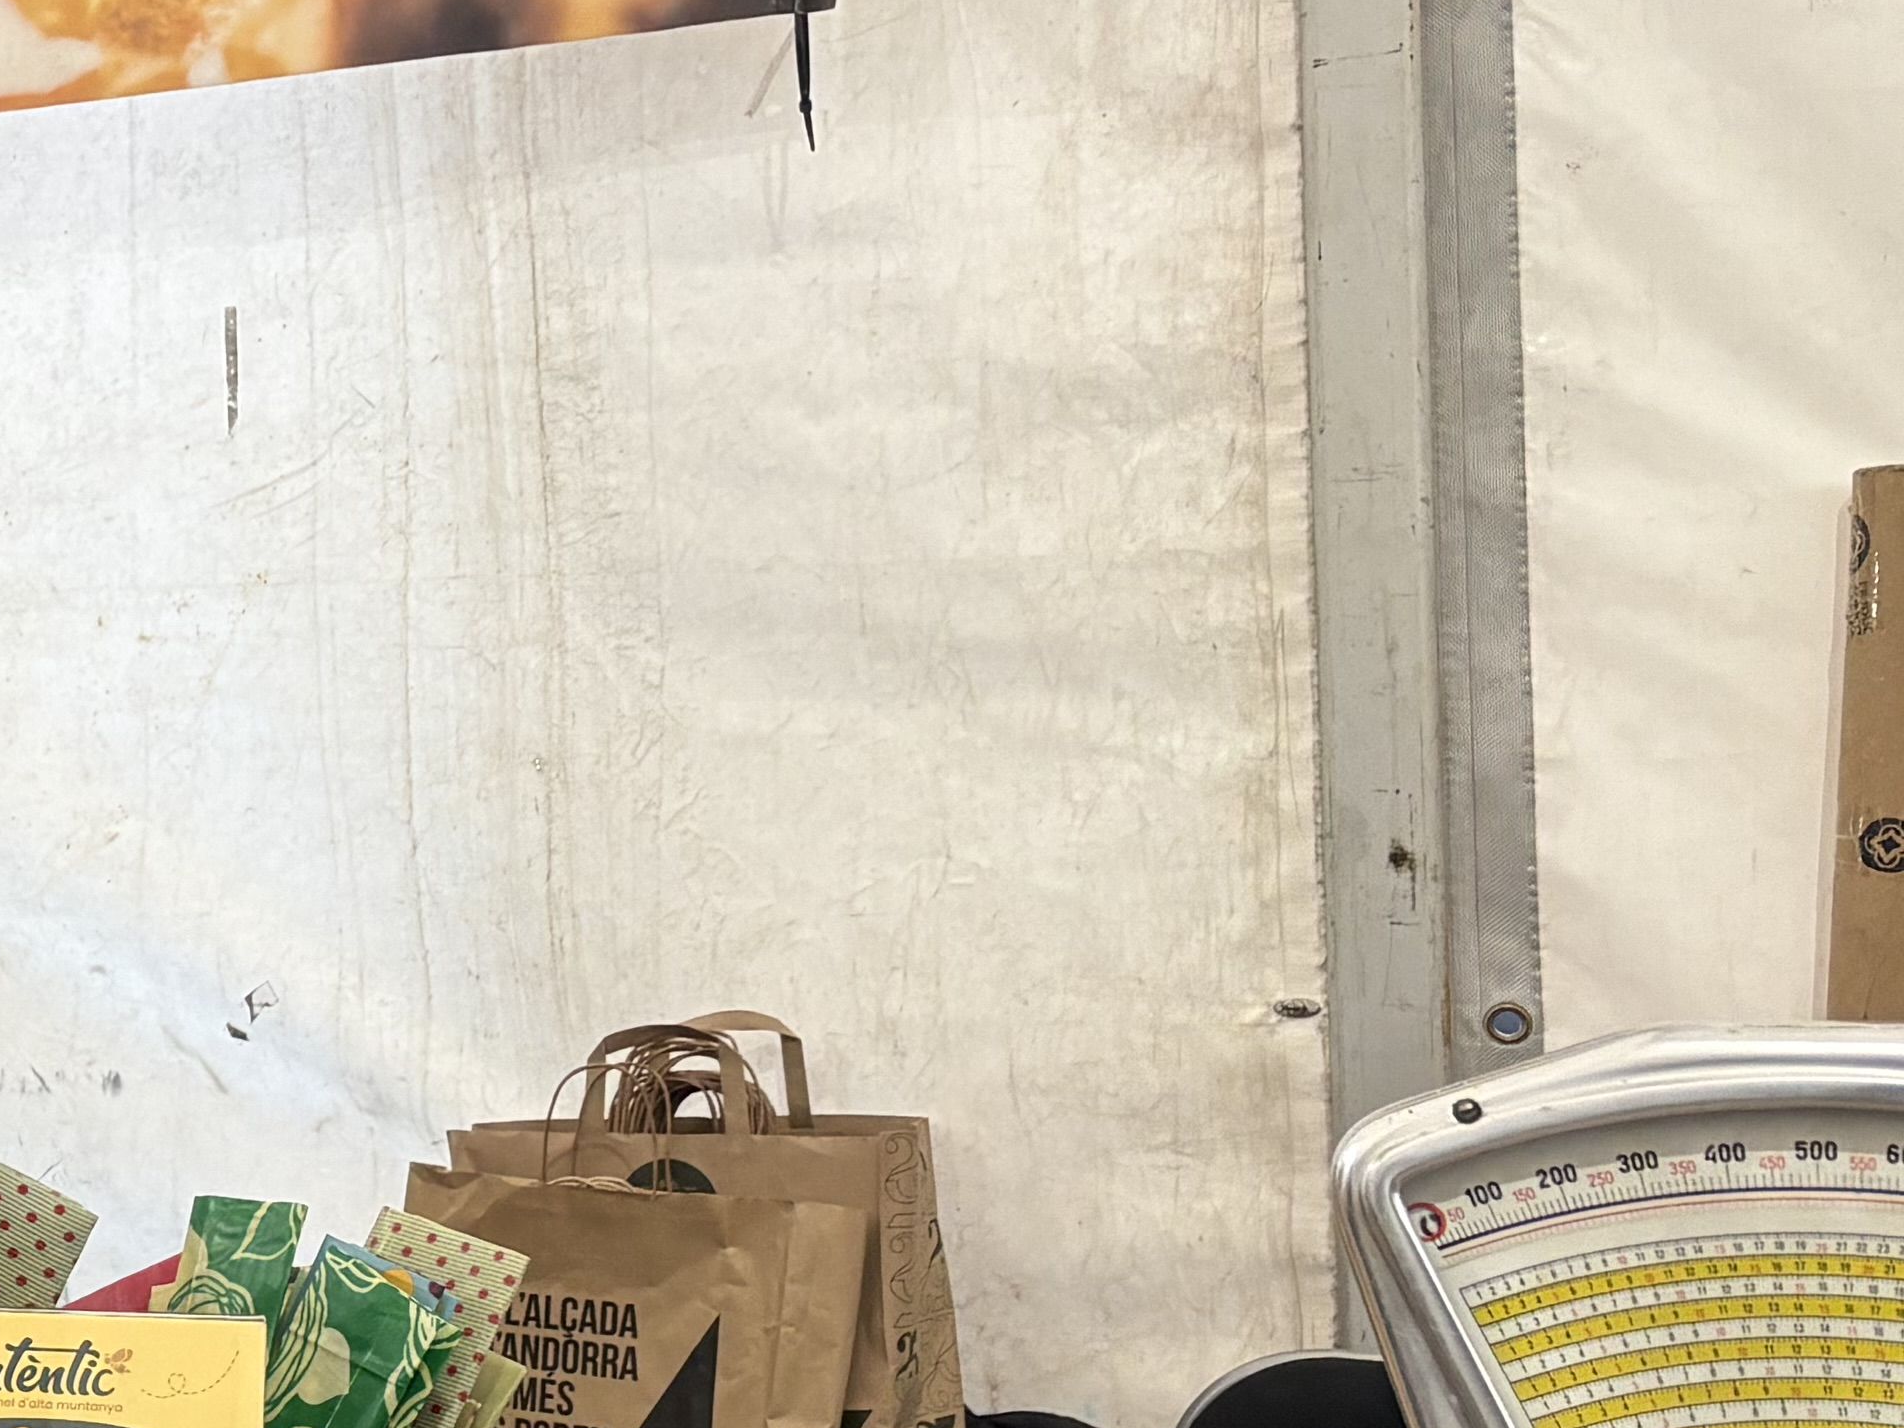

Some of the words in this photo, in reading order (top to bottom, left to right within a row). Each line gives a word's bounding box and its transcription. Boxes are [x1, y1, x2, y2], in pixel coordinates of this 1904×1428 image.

[1465, 1182, 1502, 1207] 100
[1512, 1187, 1535, 1203] 150
[1536, 1164, 1576, 1188] 200
[1587, 1171, 1614, 1187] 250
[1616, 1150, 1658, 1173] 300
[1669, 1160, 1696, 1175] 350
[1705, 1143, 1746, 1163] 400
[1759, 1156, 1785, 1171] 450
[1794, 1141, 1837, 1160] 500
[1850, 1156, 1877, 1171] 550
[491, 1332, 639, 1382] 'ANDORRA
[18, 1399, 53, 1409] d'alta
[57, 1402, 123, 1414] muntanya
[507, 1371, 575, 1416] MÉS
